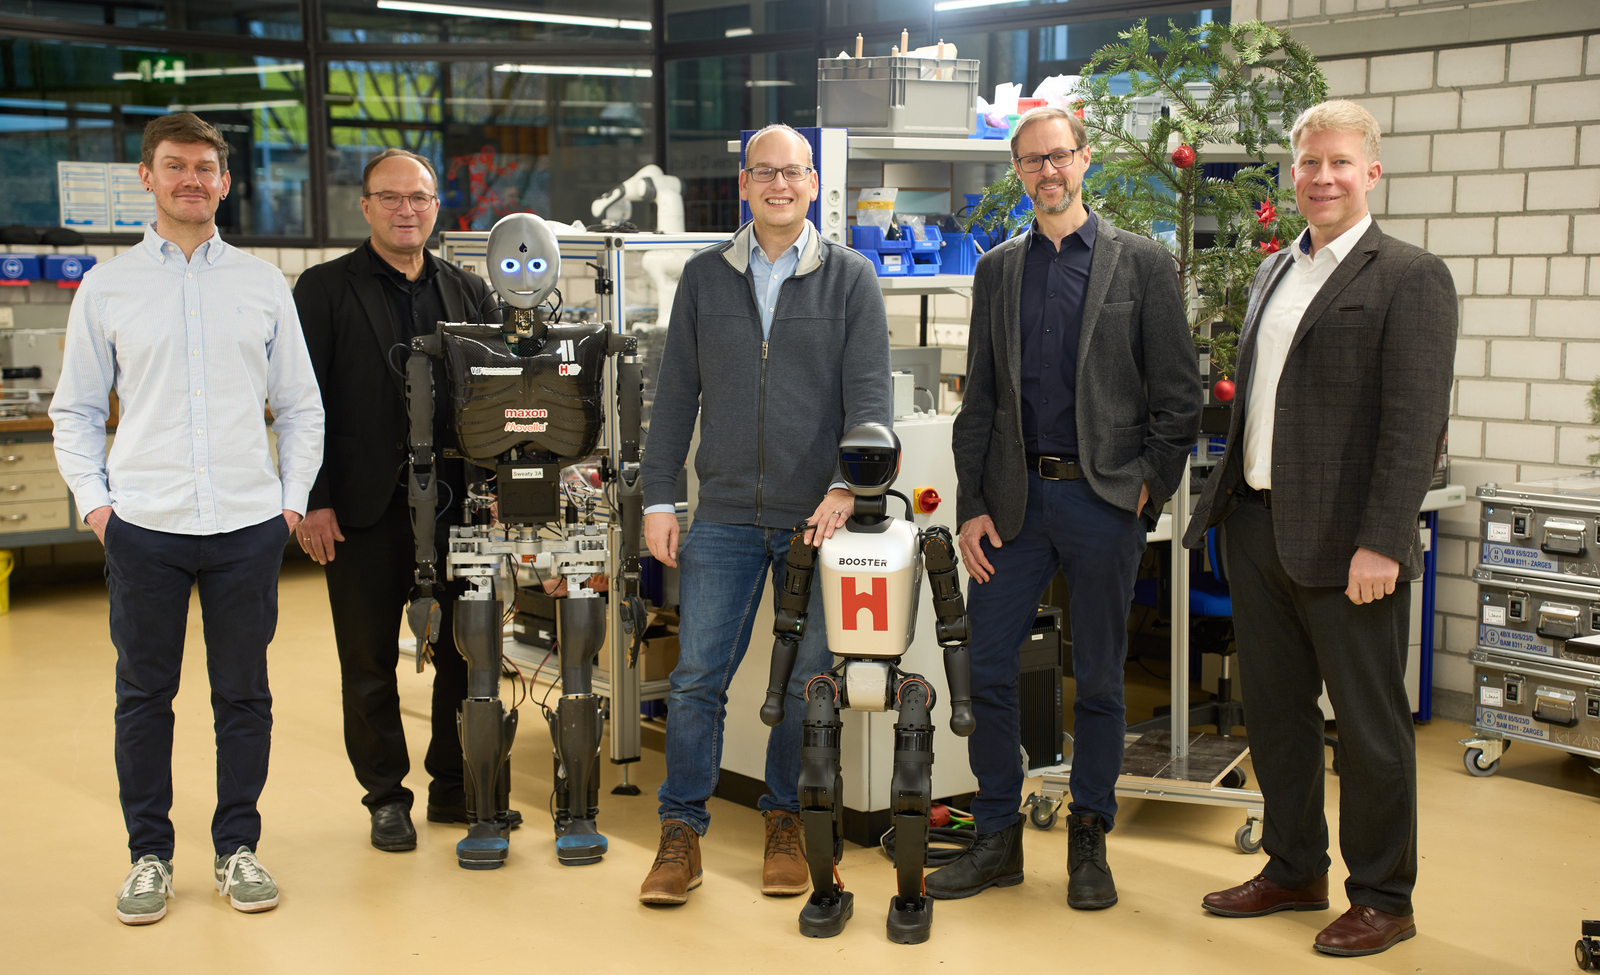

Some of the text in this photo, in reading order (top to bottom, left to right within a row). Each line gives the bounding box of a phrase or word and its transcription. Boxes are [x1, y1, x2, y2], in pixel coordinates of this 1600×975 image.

[560, 365, 568, 375] H
[505, 409, 547, 418] maxon
[504, 422, 546, 432] Movella
[1503, 548, 1515, 556] 4B/X
[838, 557, 888, 567] BOOSTER
[1503, 557, 1516, 565] BAM
[1515, 558, 1527, 566] 8311
[1530, 560, 1552, 569] ZARGES
[841, 576, 889, 632] H
[1500, 631, 1512, 639] 4B/X
[1500, 639, 1511, 647] BAM
[1511, 641, 1523, 649] 8311
[1526, 643, 1548, 653] ZARGES
[1496, 711, 1508, 720] 4B/X
[1496, 721, 1508, 729] BAM
[1508, 723, 1519, 732] 8311
[1522, 726, 1544, 737] ZARGES
